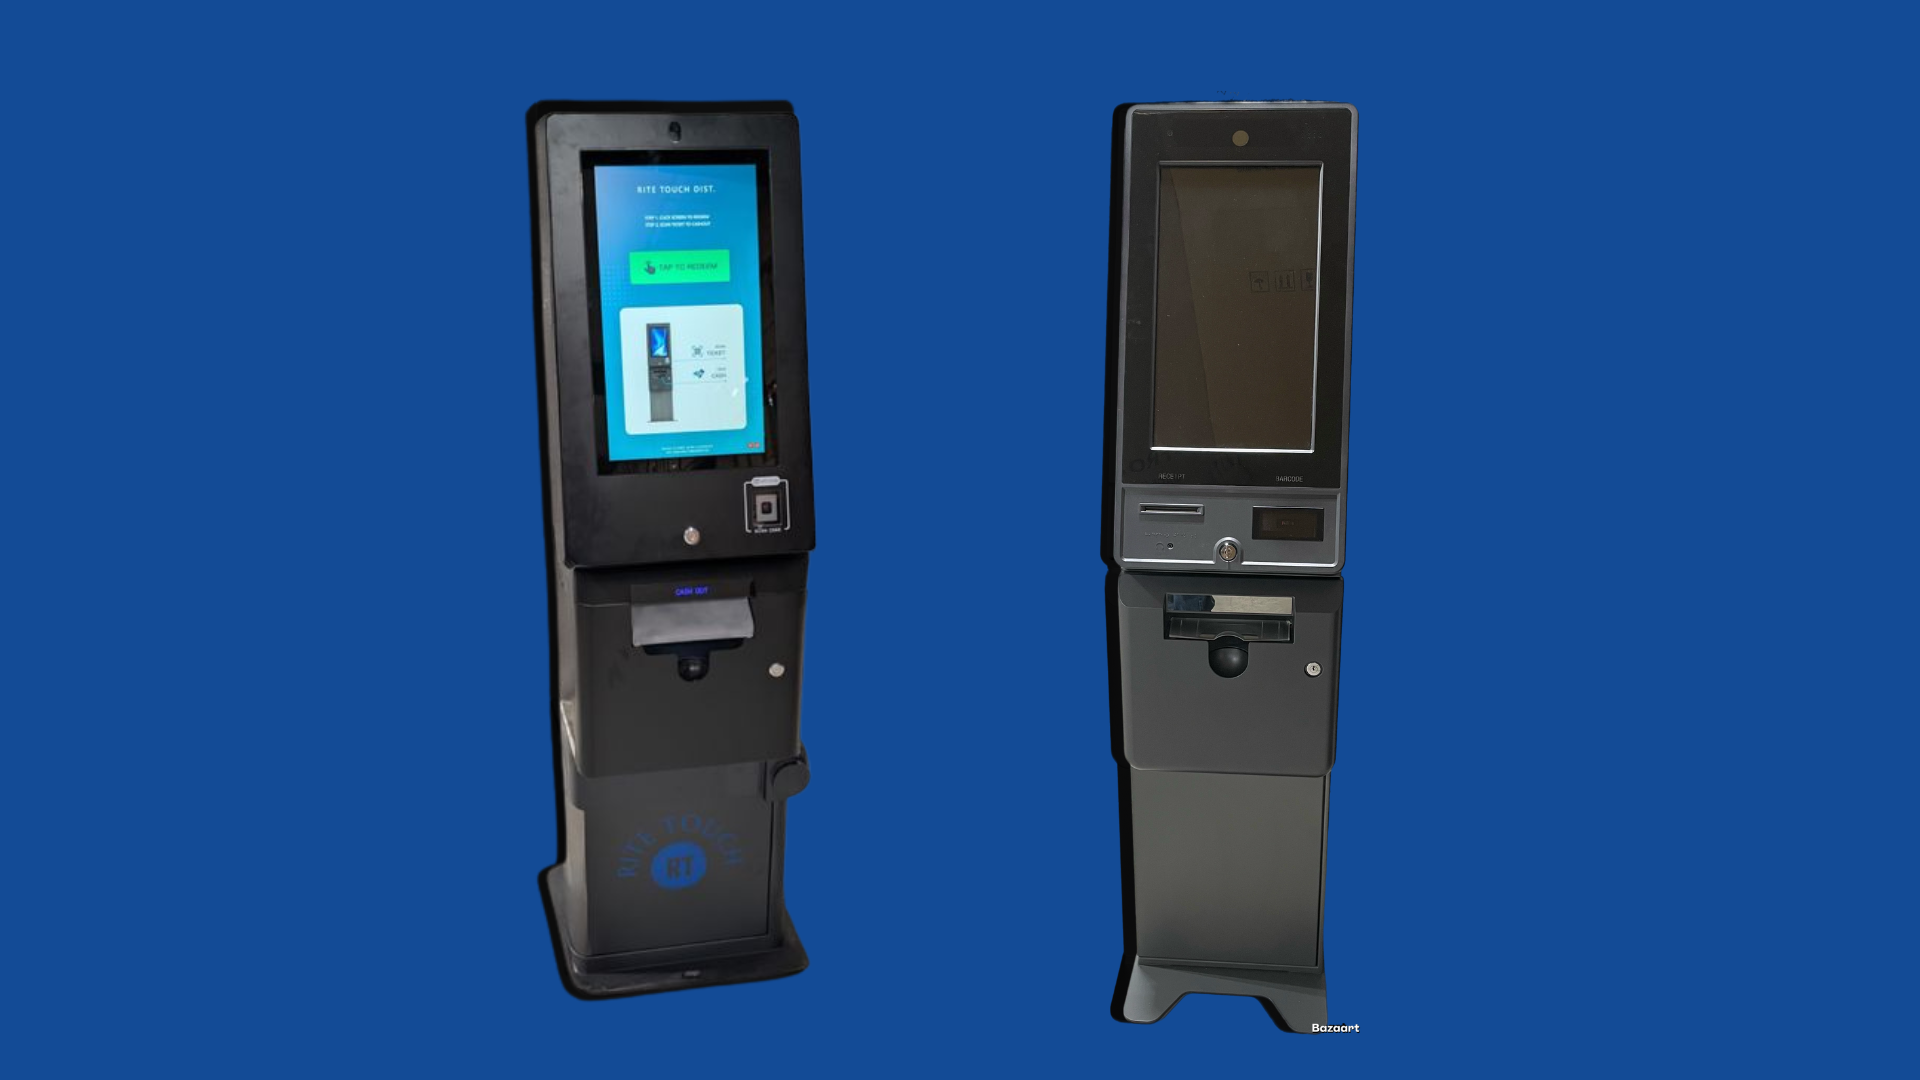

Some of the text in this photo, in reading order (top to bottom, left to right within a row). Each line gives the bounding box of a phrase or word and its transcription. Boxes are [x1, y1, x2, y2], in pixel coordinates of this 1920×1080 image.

[637, 185, 716, 194] RITE TOUCH DIST.
[659, 263, 673, 271] TAP
[675, 263, 686, 271] TO
[1158, 472, 1186, 480] RECEIPT
[1275, 475, 1304, 483] BARCODE
[666, 856, 694, 880] RT
